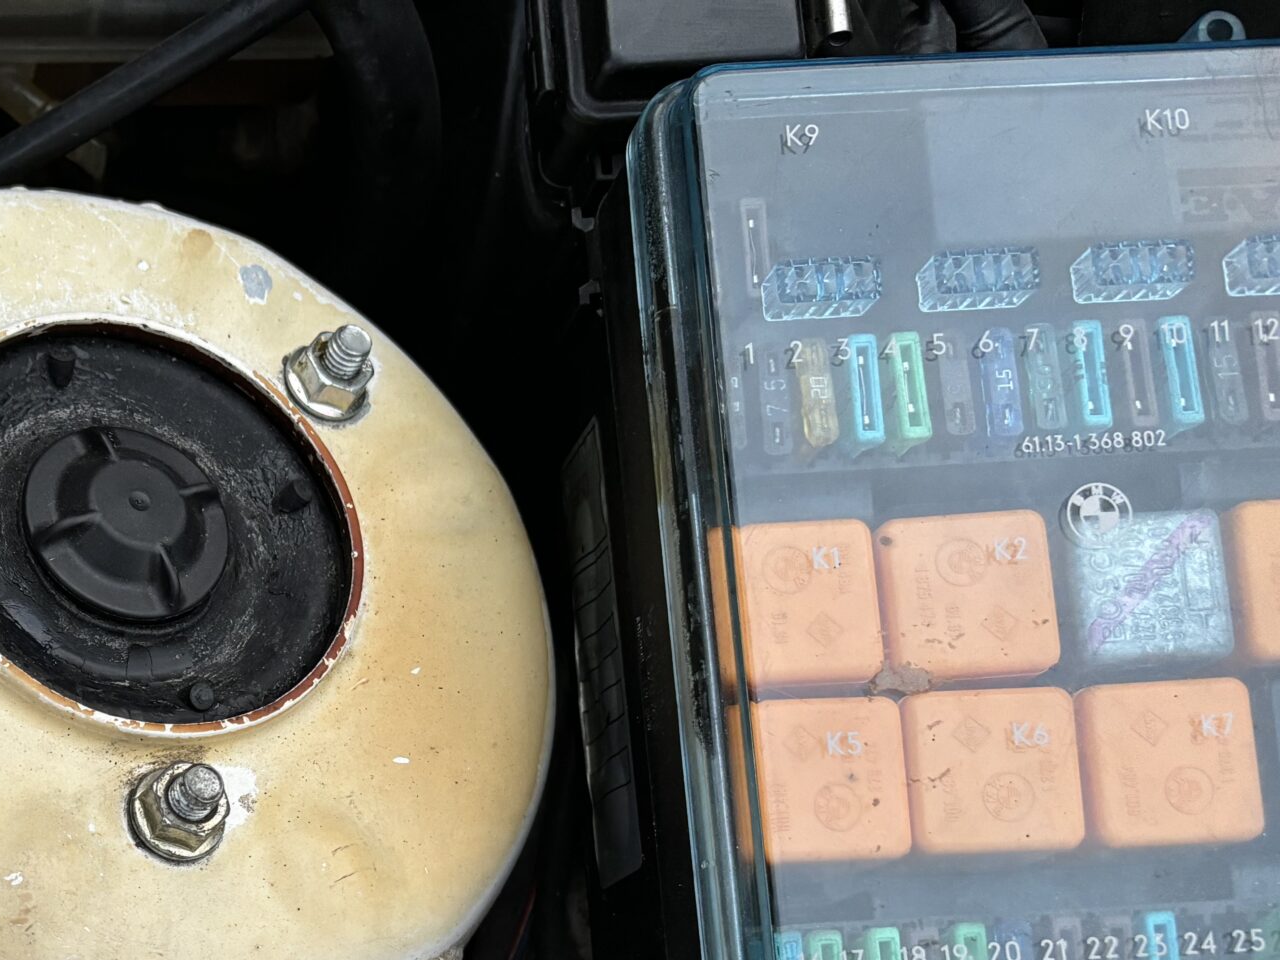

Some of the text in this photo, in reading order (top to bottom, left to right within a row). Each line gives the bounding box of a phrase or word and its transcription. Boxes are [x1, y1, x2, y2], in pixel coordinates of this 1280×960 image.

[1145, 108, 1190, 130] K10
[785, 124, 820, 148] K9
[744, 317, 1279, 365] 1 2 3 4 5 6 7 8 9 10 11 12
[995, 368, 1014, 391] 15
[1021, 429, 1167, 454] 61.13-1 368 802
[812, 546, 842, 570] K1
[993, 537, 1029, 561] K2
[1011, 722, 1049, 747] K6
[1201, 711, 1235, 736] K7
[826, 731, 863, 756] K5
[1087, 936, 1119, 959] 22
[1134, 934, 1167, 957] 23
[1184, 931, 1216, 955] 24
[1232, 928, 1265, 952] 25
